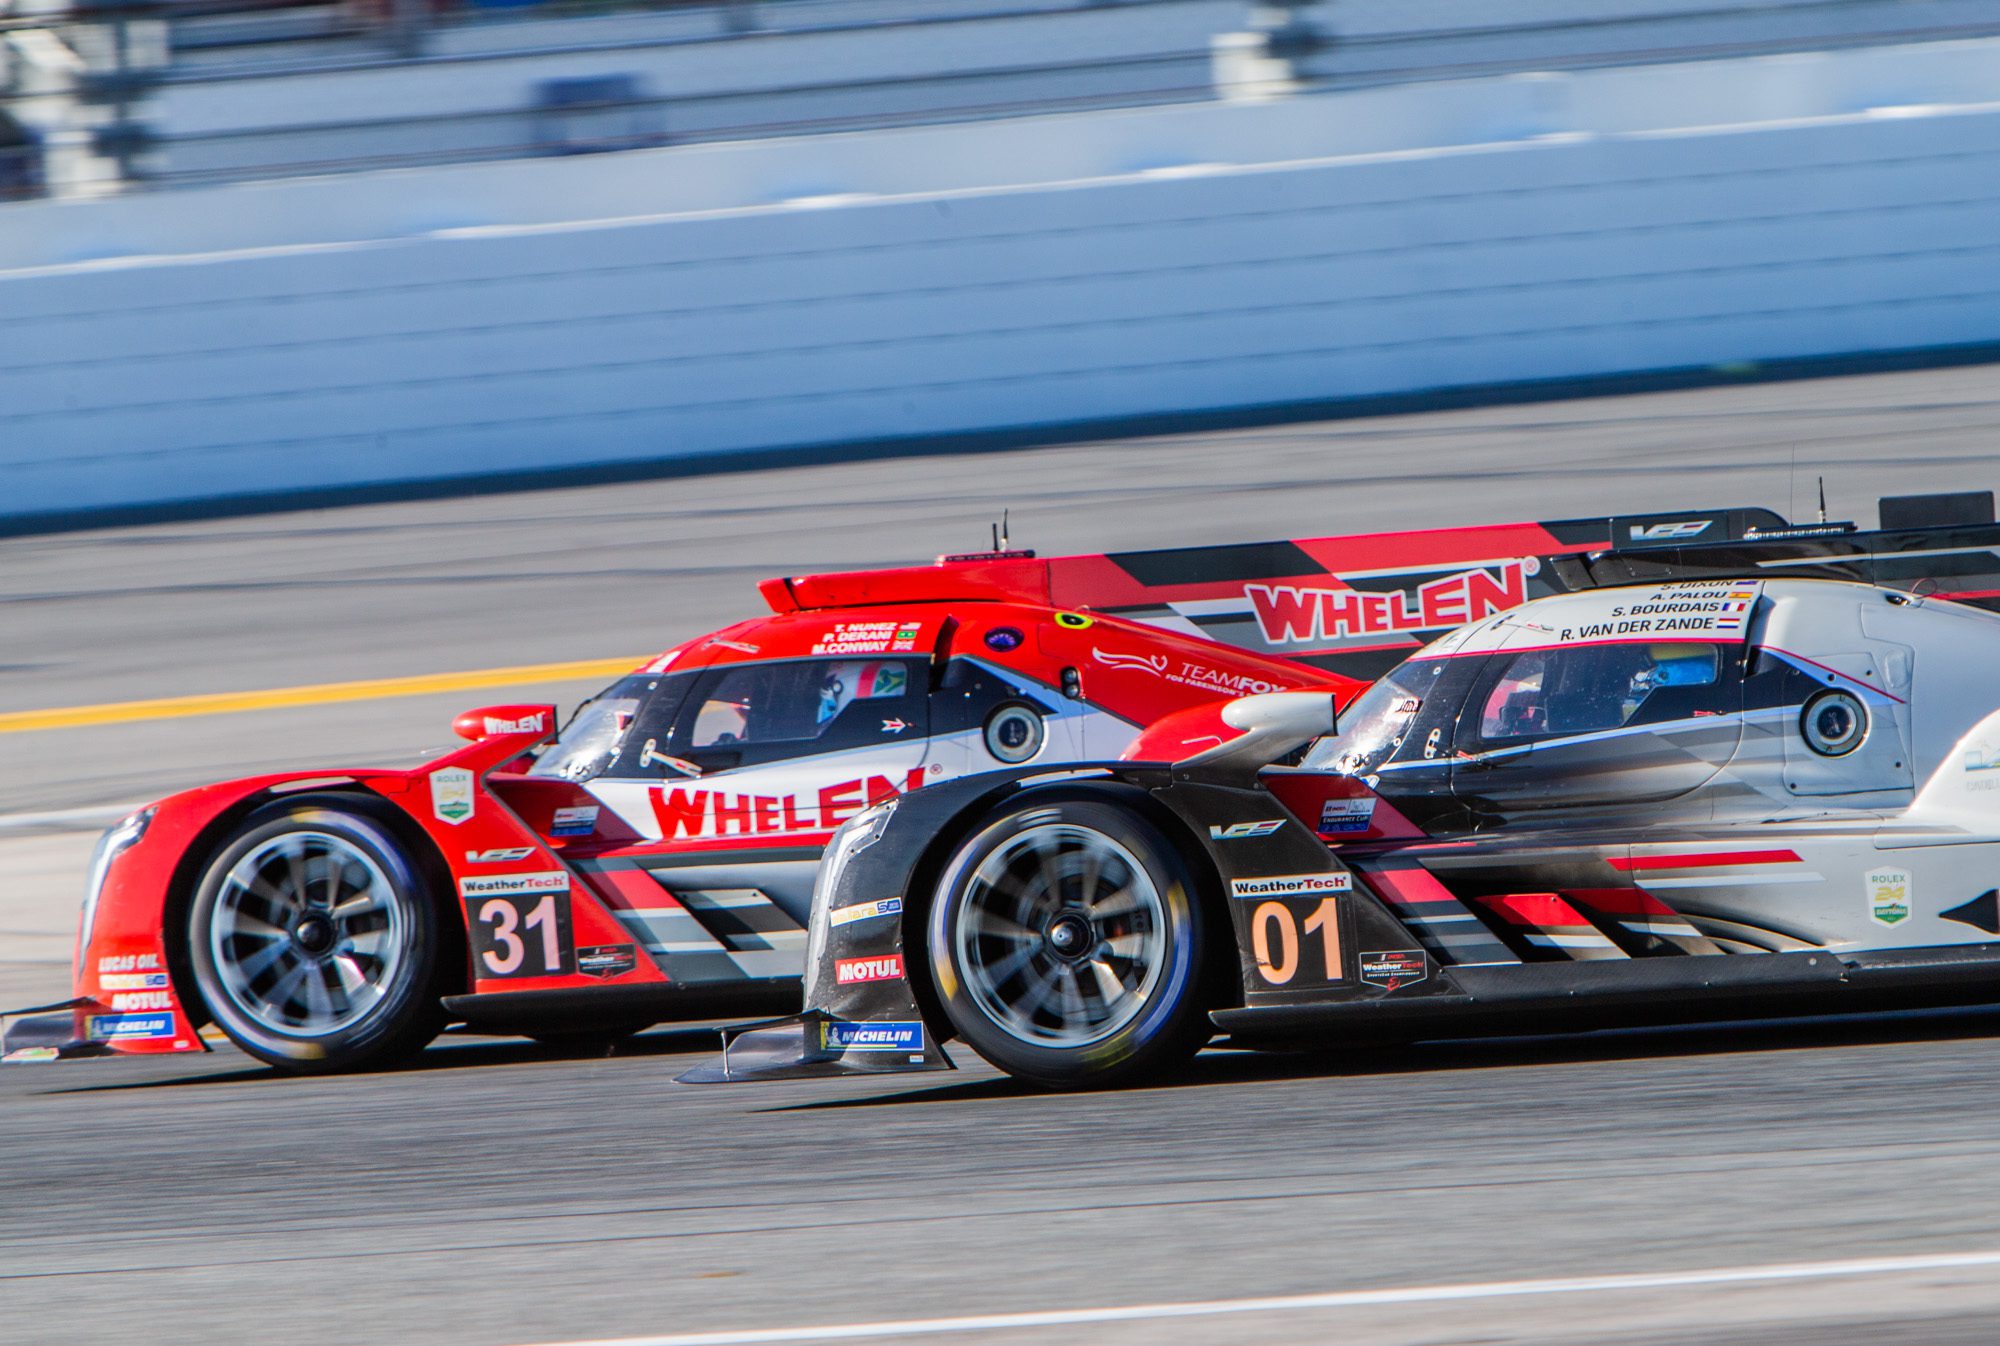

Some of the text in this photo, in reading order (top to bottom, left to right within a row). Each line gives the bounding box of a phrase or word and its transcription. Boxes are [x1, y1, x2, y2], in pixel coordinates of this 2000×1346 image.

[1247, 562, 1528, 643] WHELEN
[1670, 591, 1728, 600] PALOU
[1612, 602, 1719, 617] S. BOURDAIS
[822, 631, 892, 642] P. DERANI
[1560, 618, 1715, 641] R. VAN DER ZANDE
[1165, 673, 1183, 682] FOR
[483, 712, 543, 734] WHELEN
[464, 876, 563, 891] WeatherTech
[1235, 877, 1344, 894] WeatherTech
[1872, 874, 1905, 883] ROLEX
[1874, 886, 1905, 901] 24
[479, 896, 560, 974] 31
[1252, 897, 1343, 985] 01
[99, 953, 159, 972] LUCAS OIL
[839, 959, 900, 981] MOTUL
[1363, 962, 1424, 971] WeatherTech
[111, 991, 173, 1011] MOTUL
[842, 1031, 912, 1042] MICHELIN
